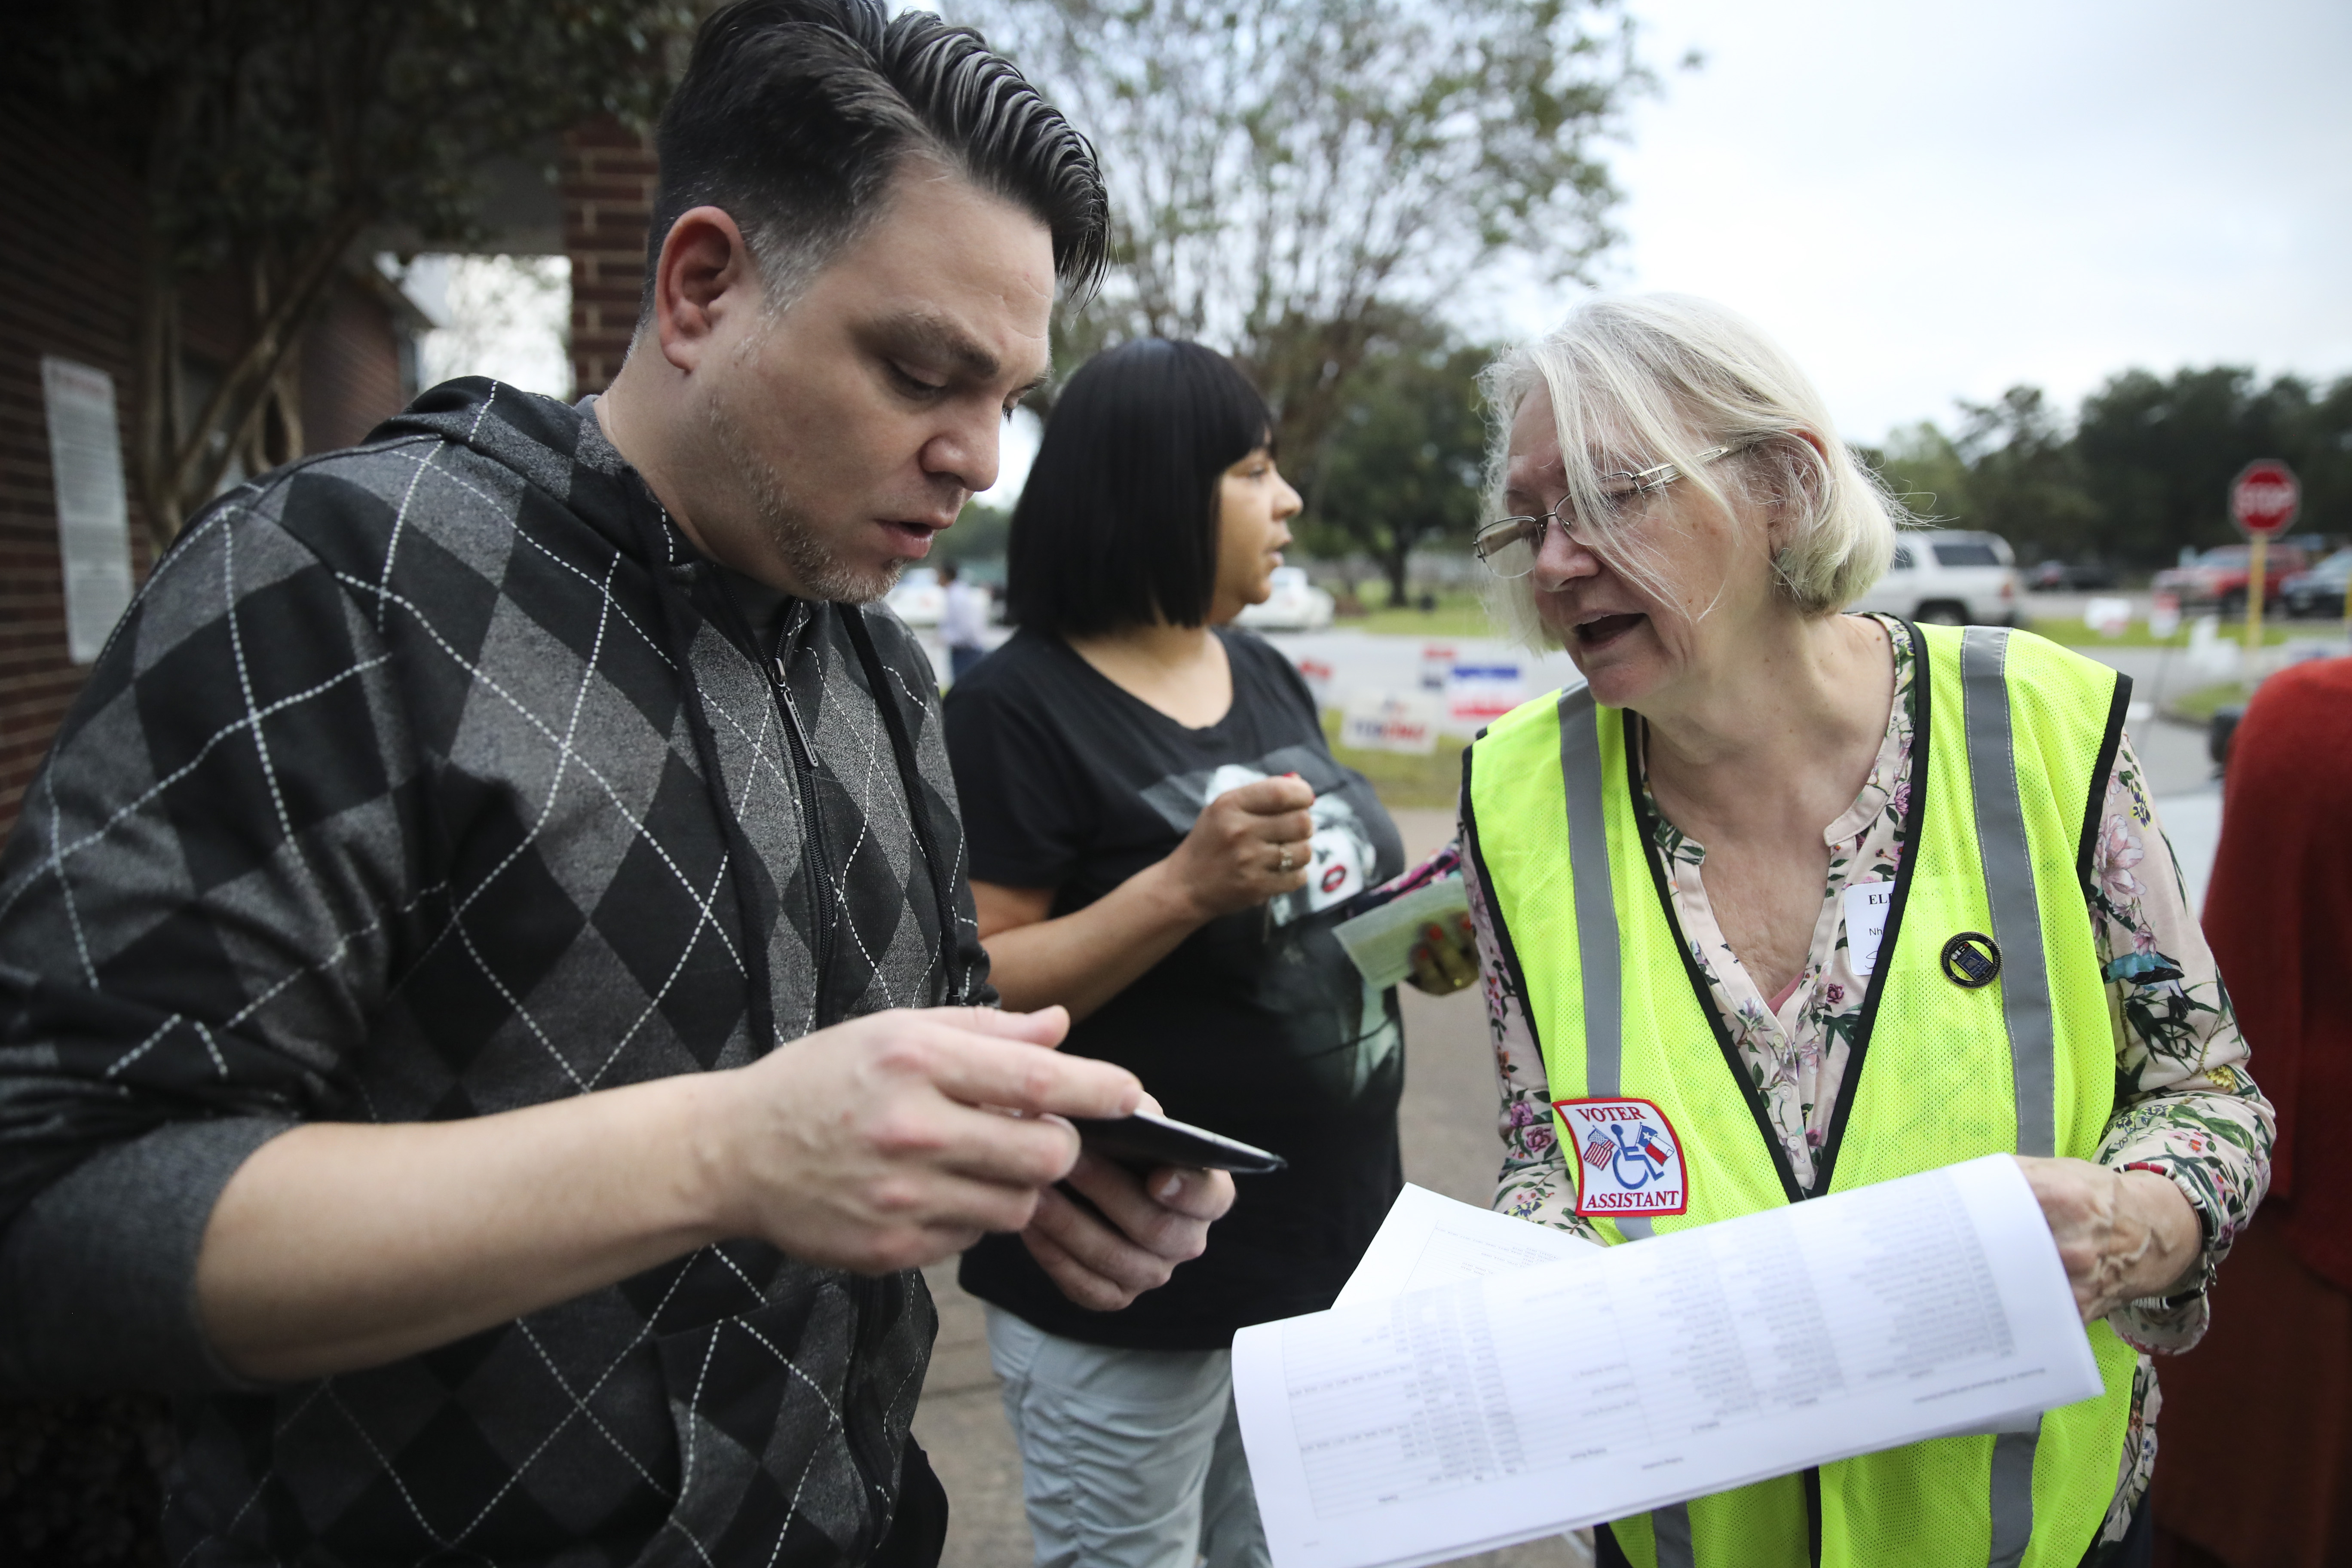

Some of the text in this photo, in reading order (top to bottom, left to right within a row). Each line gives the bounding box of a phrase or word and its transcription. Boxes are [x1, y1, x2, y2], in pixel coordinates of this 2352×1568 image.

[1869, 928, 1883, 936] Nh
[1575, 1106, 1647, 1122] VOTER
[1586, 1190, 1679, 1209] ASSISTANT
